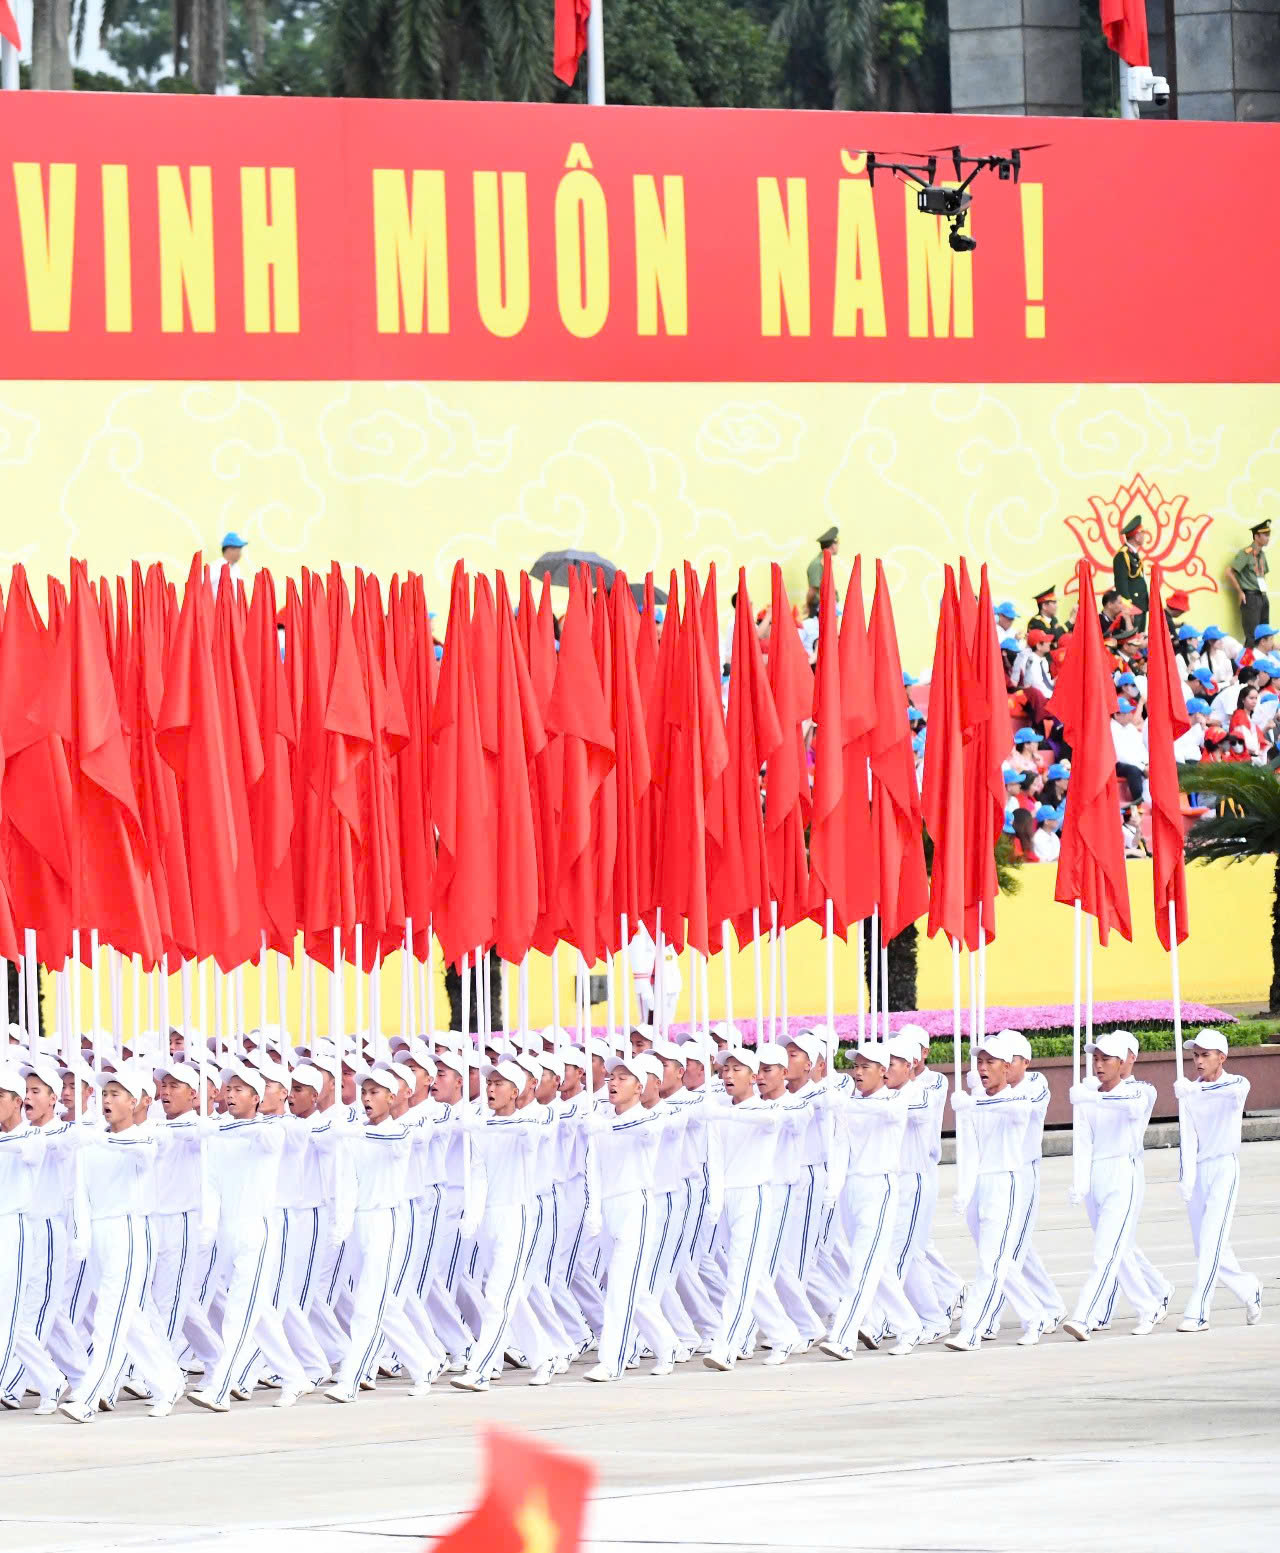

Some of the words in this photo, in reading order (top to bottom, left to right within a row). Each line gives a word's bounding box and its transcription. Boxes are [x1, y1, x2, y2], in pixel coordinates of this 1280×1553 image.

[13, 162, 300, 333] VINH
[372, 142, 688, 337] MUÔN
[757, 148, 973, 338] NĂM
[1020, 183, 1045, 338] !
